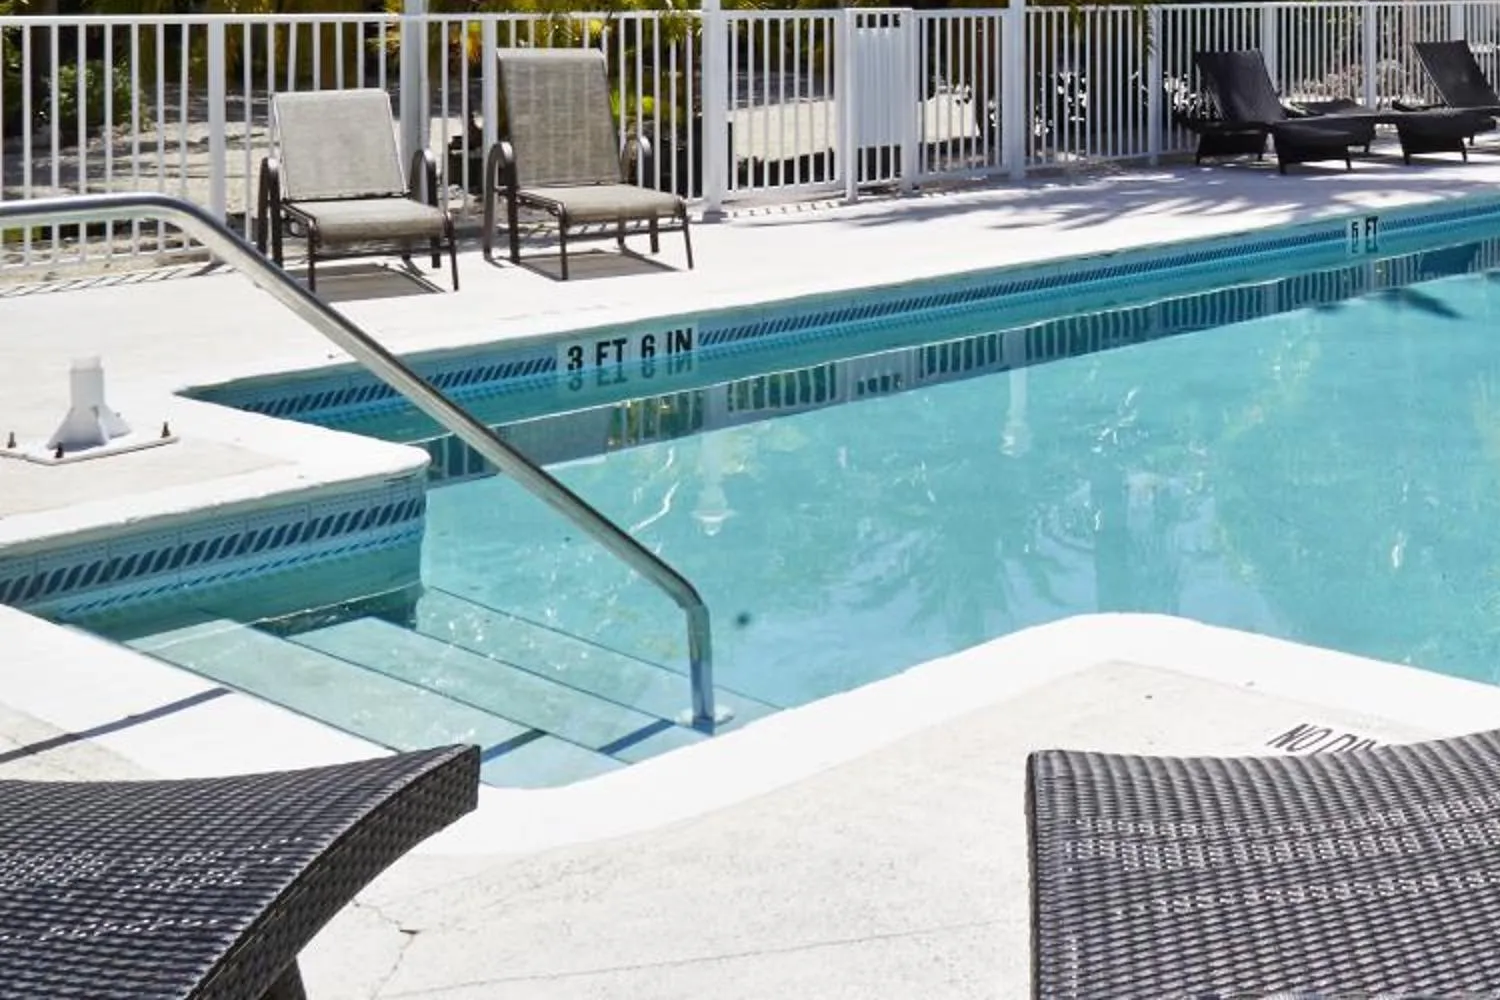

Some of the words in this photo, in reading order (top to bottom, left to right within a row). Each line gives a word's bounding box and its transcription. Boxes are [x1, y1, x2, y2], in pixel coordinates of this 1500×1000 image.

[1365, 215, 1379, 237] FT
[567, 345, 584, 371] 3
[595, 337, 627, 366] FT
[641, 334, 655, 358] 6
[667, 327, 693, 355] IN
[1265, 723, 1334, 752] NO
